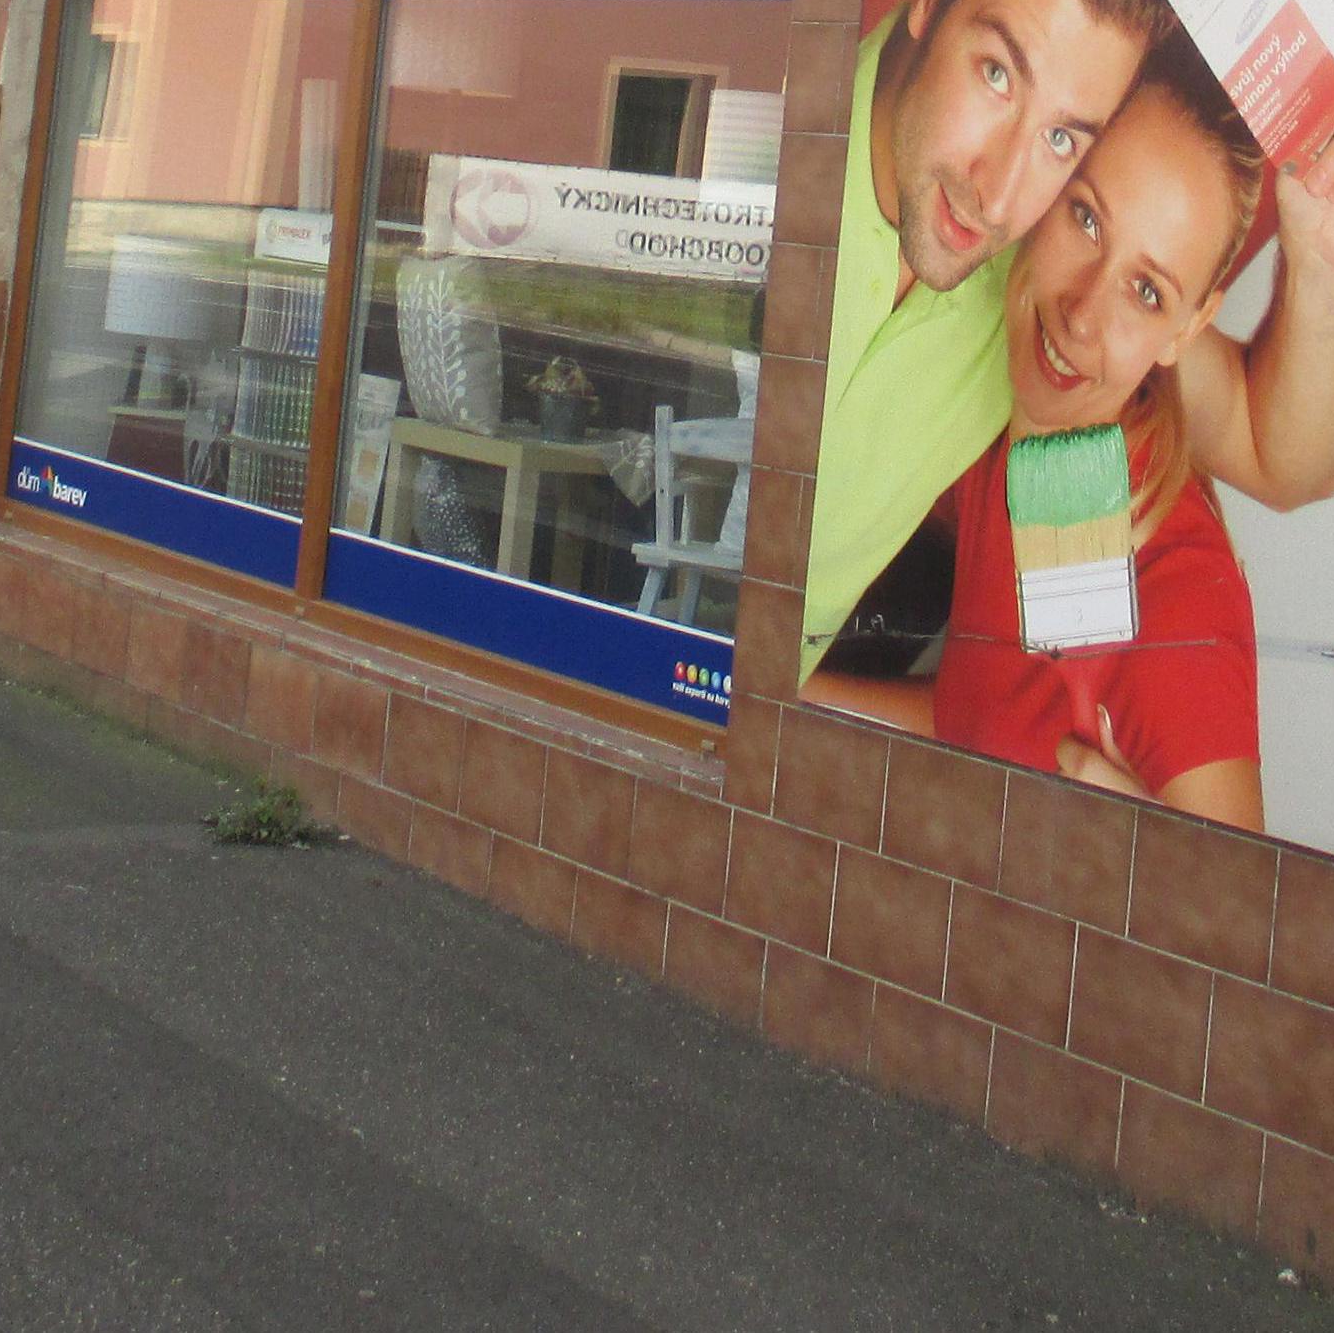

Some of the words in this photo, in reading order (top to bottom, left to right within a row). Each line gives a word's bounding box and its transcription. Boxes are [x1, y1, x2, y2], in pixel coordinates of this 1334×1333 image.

[1252, 32, 1283, 72] nový
[1272, 29, 1308, 74] výhod
[17, 465, 41, 493] dům
[52, 475, 88, 508] barev
